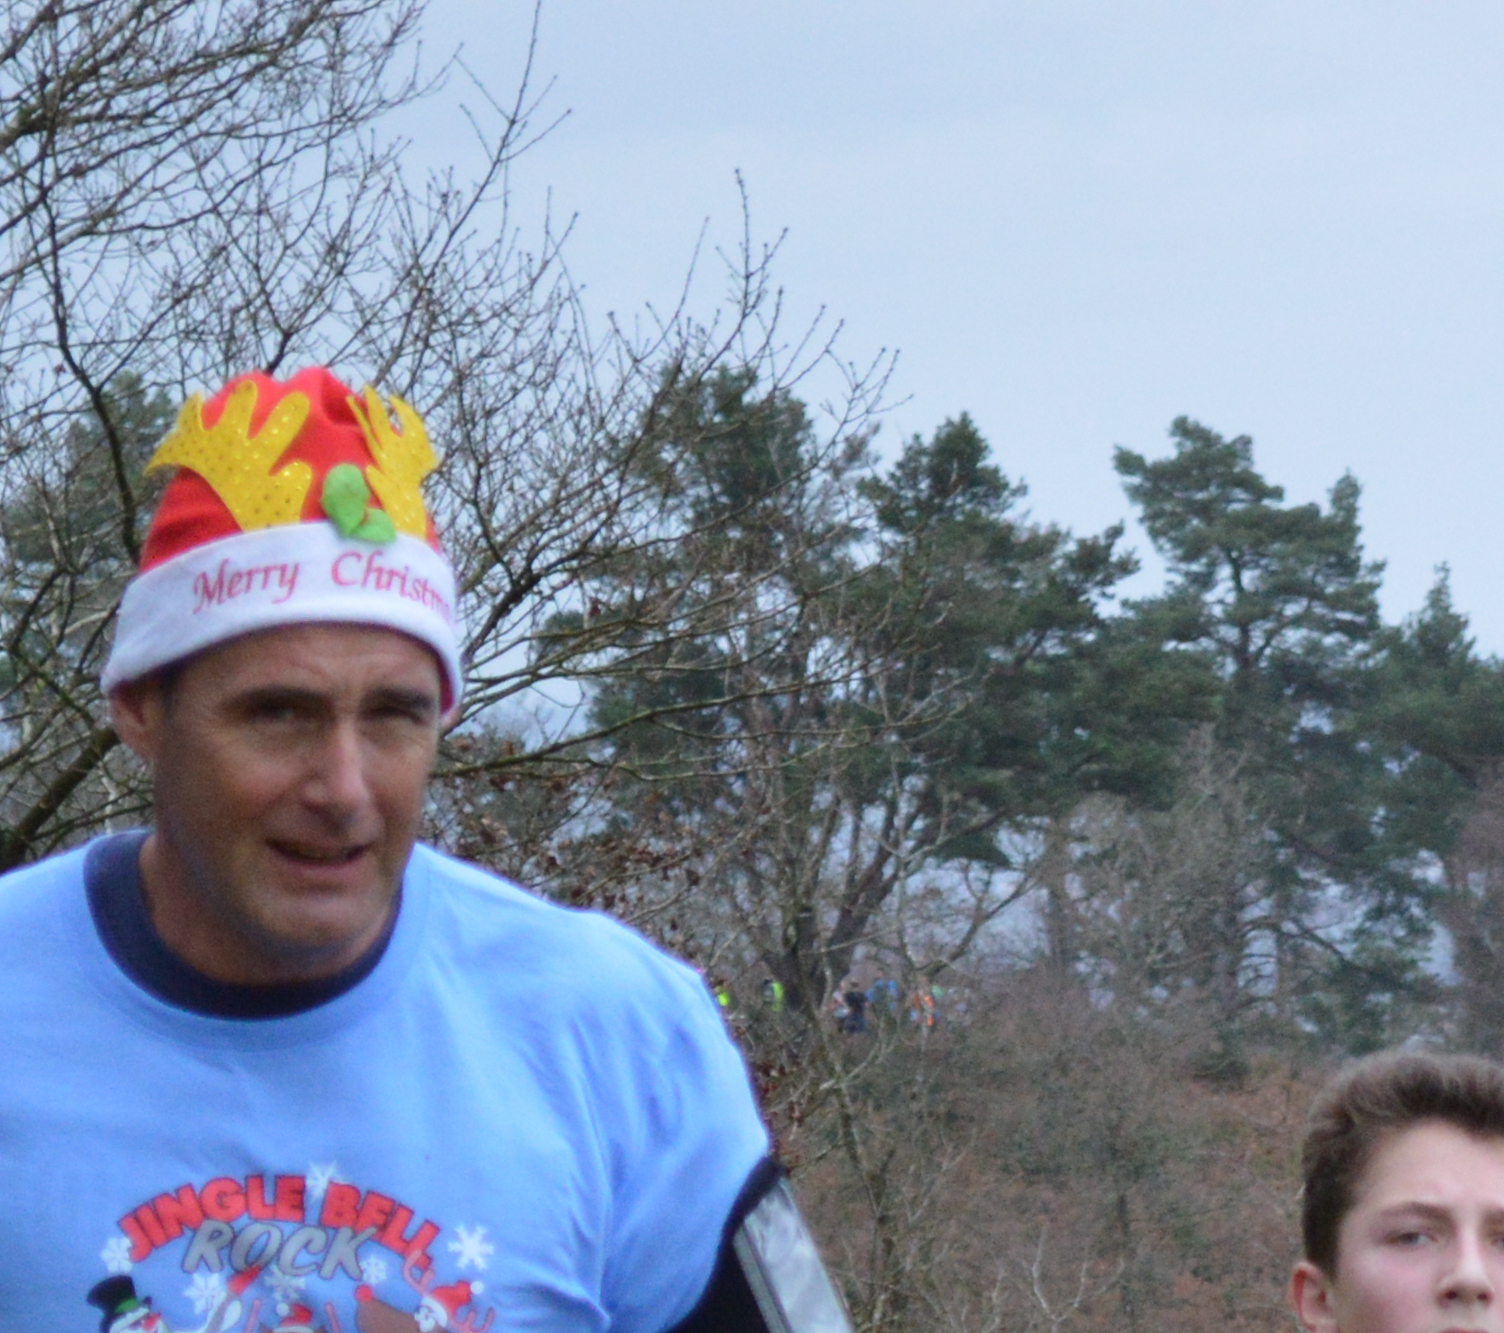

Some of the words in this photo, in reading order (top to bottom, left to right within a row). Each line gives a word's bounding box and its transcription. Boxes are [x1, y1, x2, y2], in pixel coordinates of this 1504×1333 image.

[192, 556, 302, 616] Merry
[117, 1174, 307, 1263] JINGLE
[319, 1179, 441, 1271] BELL
[181, 1219, 378, 1282] ROCK
